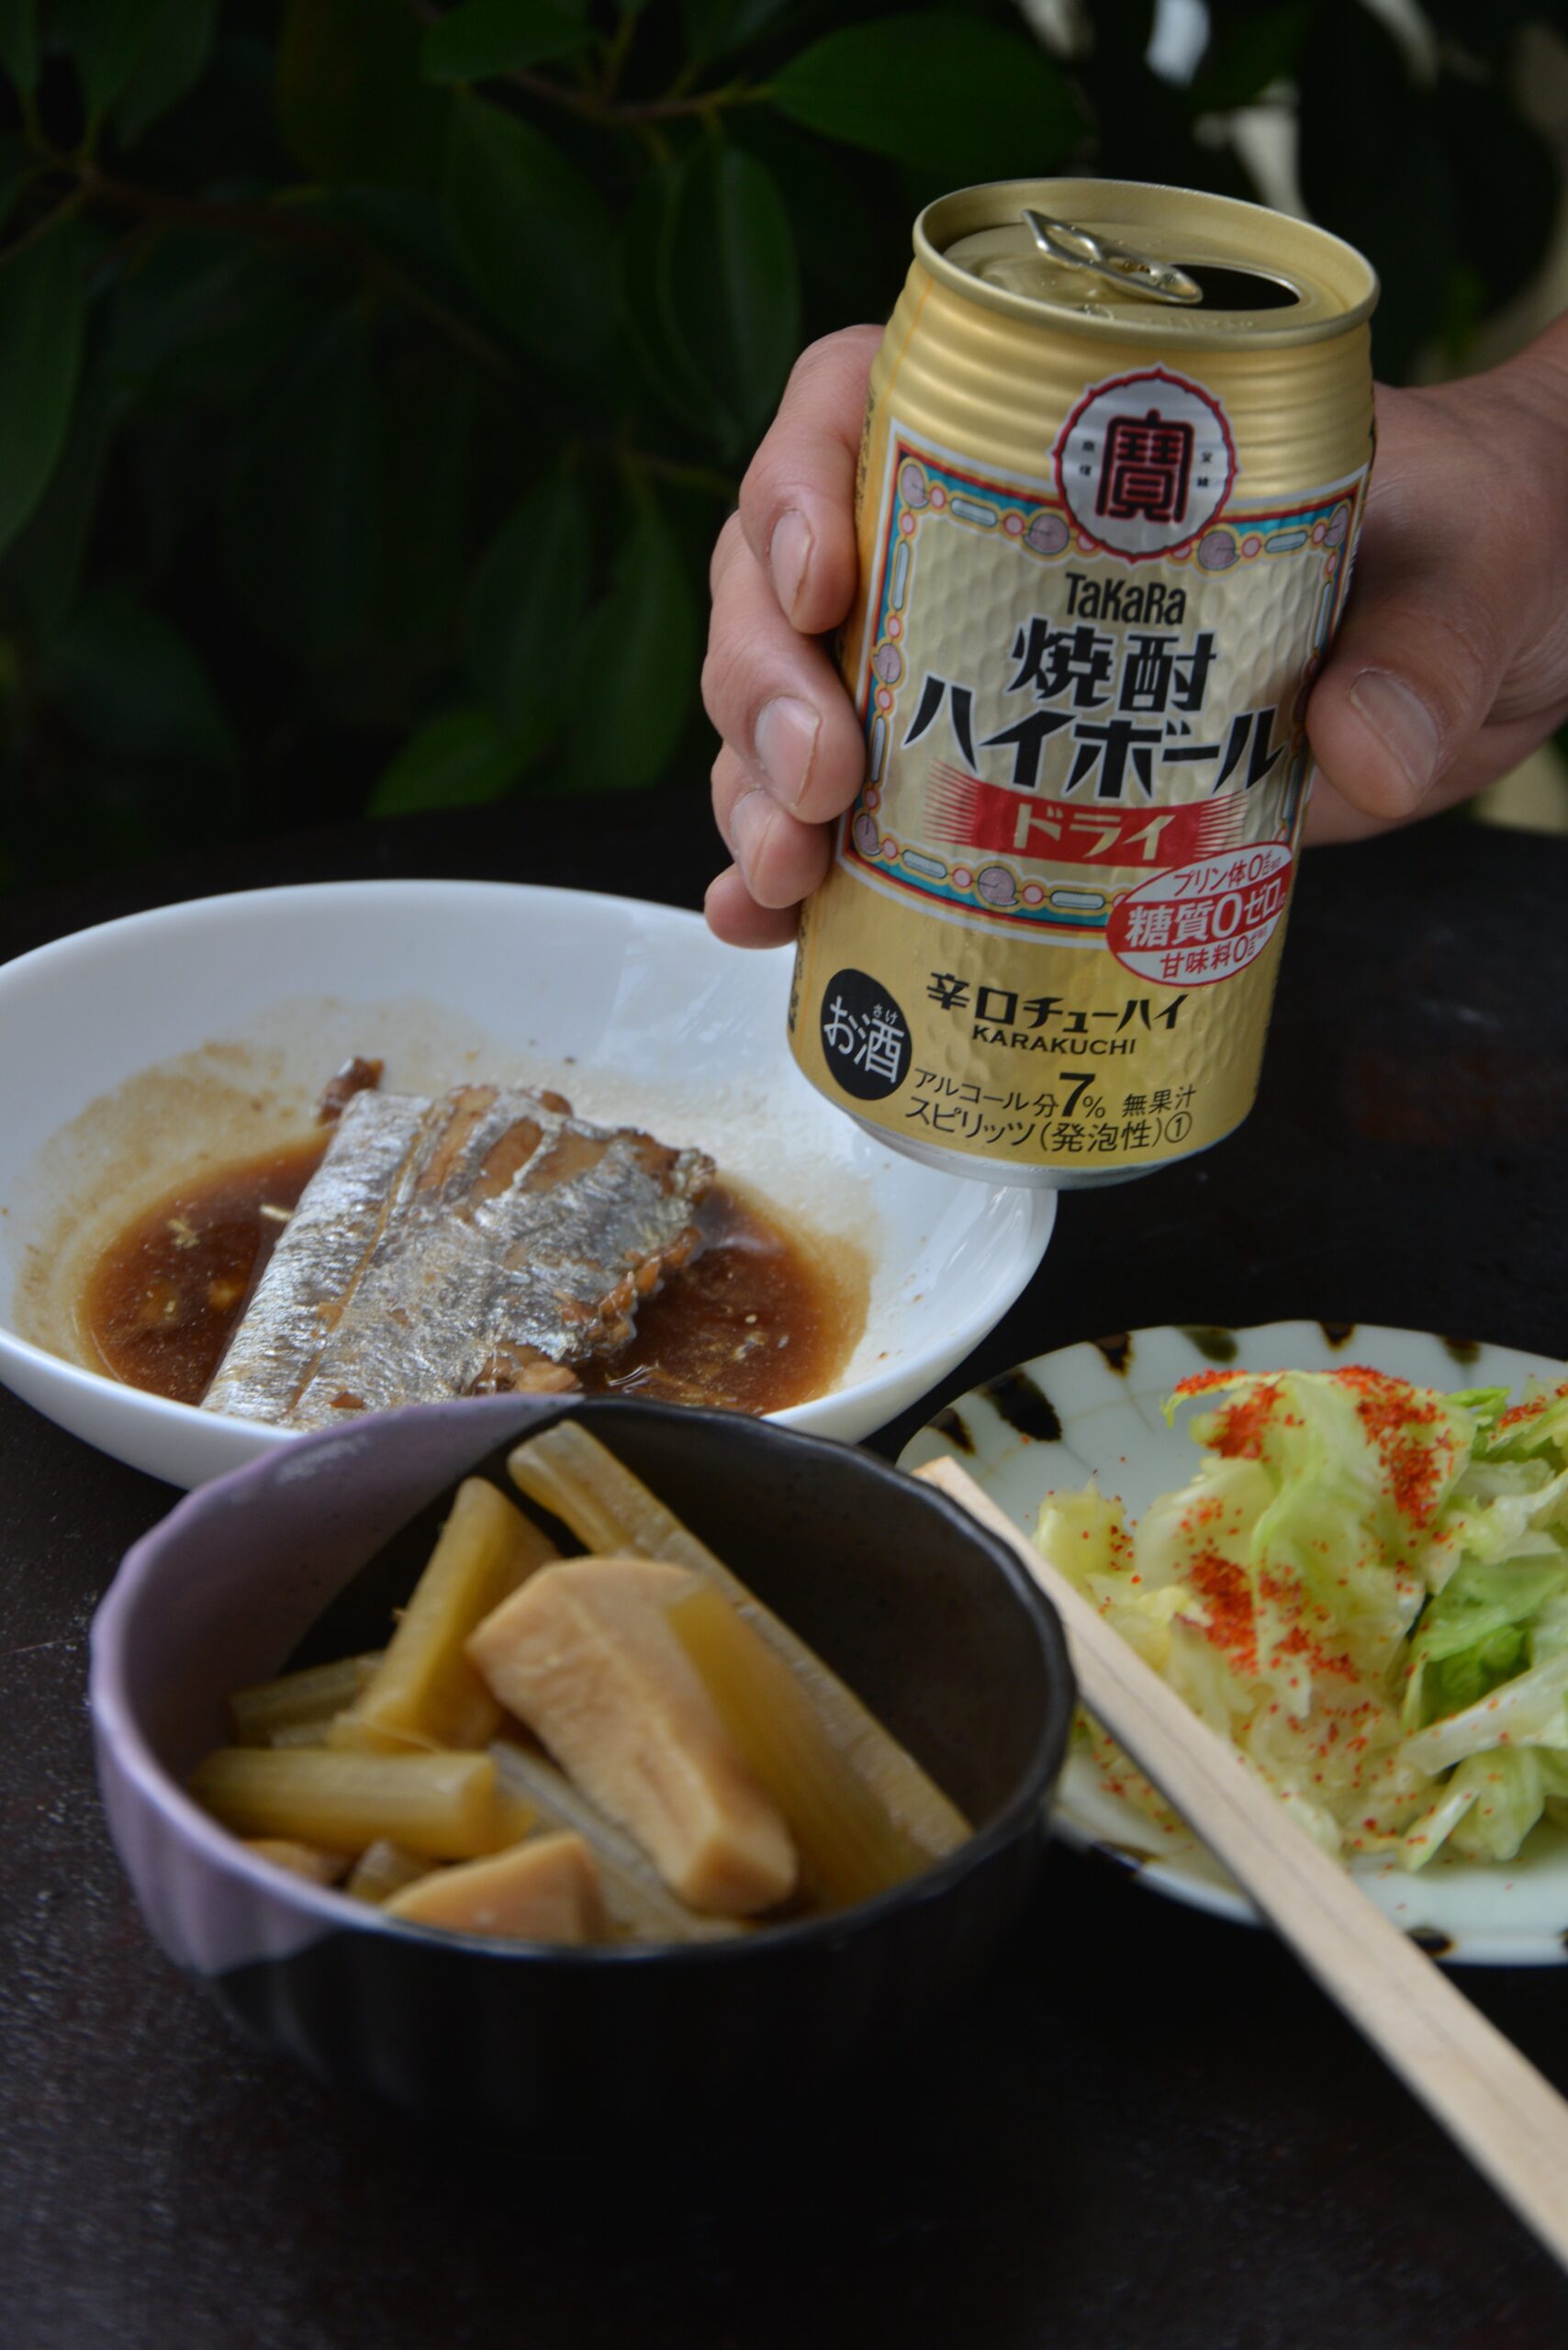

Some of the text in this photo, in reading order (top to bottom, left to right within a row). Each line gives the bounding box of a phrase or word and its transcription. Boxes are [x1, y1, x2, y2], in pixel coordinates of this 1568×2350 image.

[1007, 616, 1217, 713] 焼酎
[902, 675, 1285, 800] ハイボール
[1013, 802, 1176, 862] ドライ
[925, 971, 1190, 1035] 辛口チューハイ
[823, 994, 905, 1084] お酒
[972, 1024, 1137, 1056] KARAKUCHI
[1122, 1085, 1197, 1116] 無果汁
